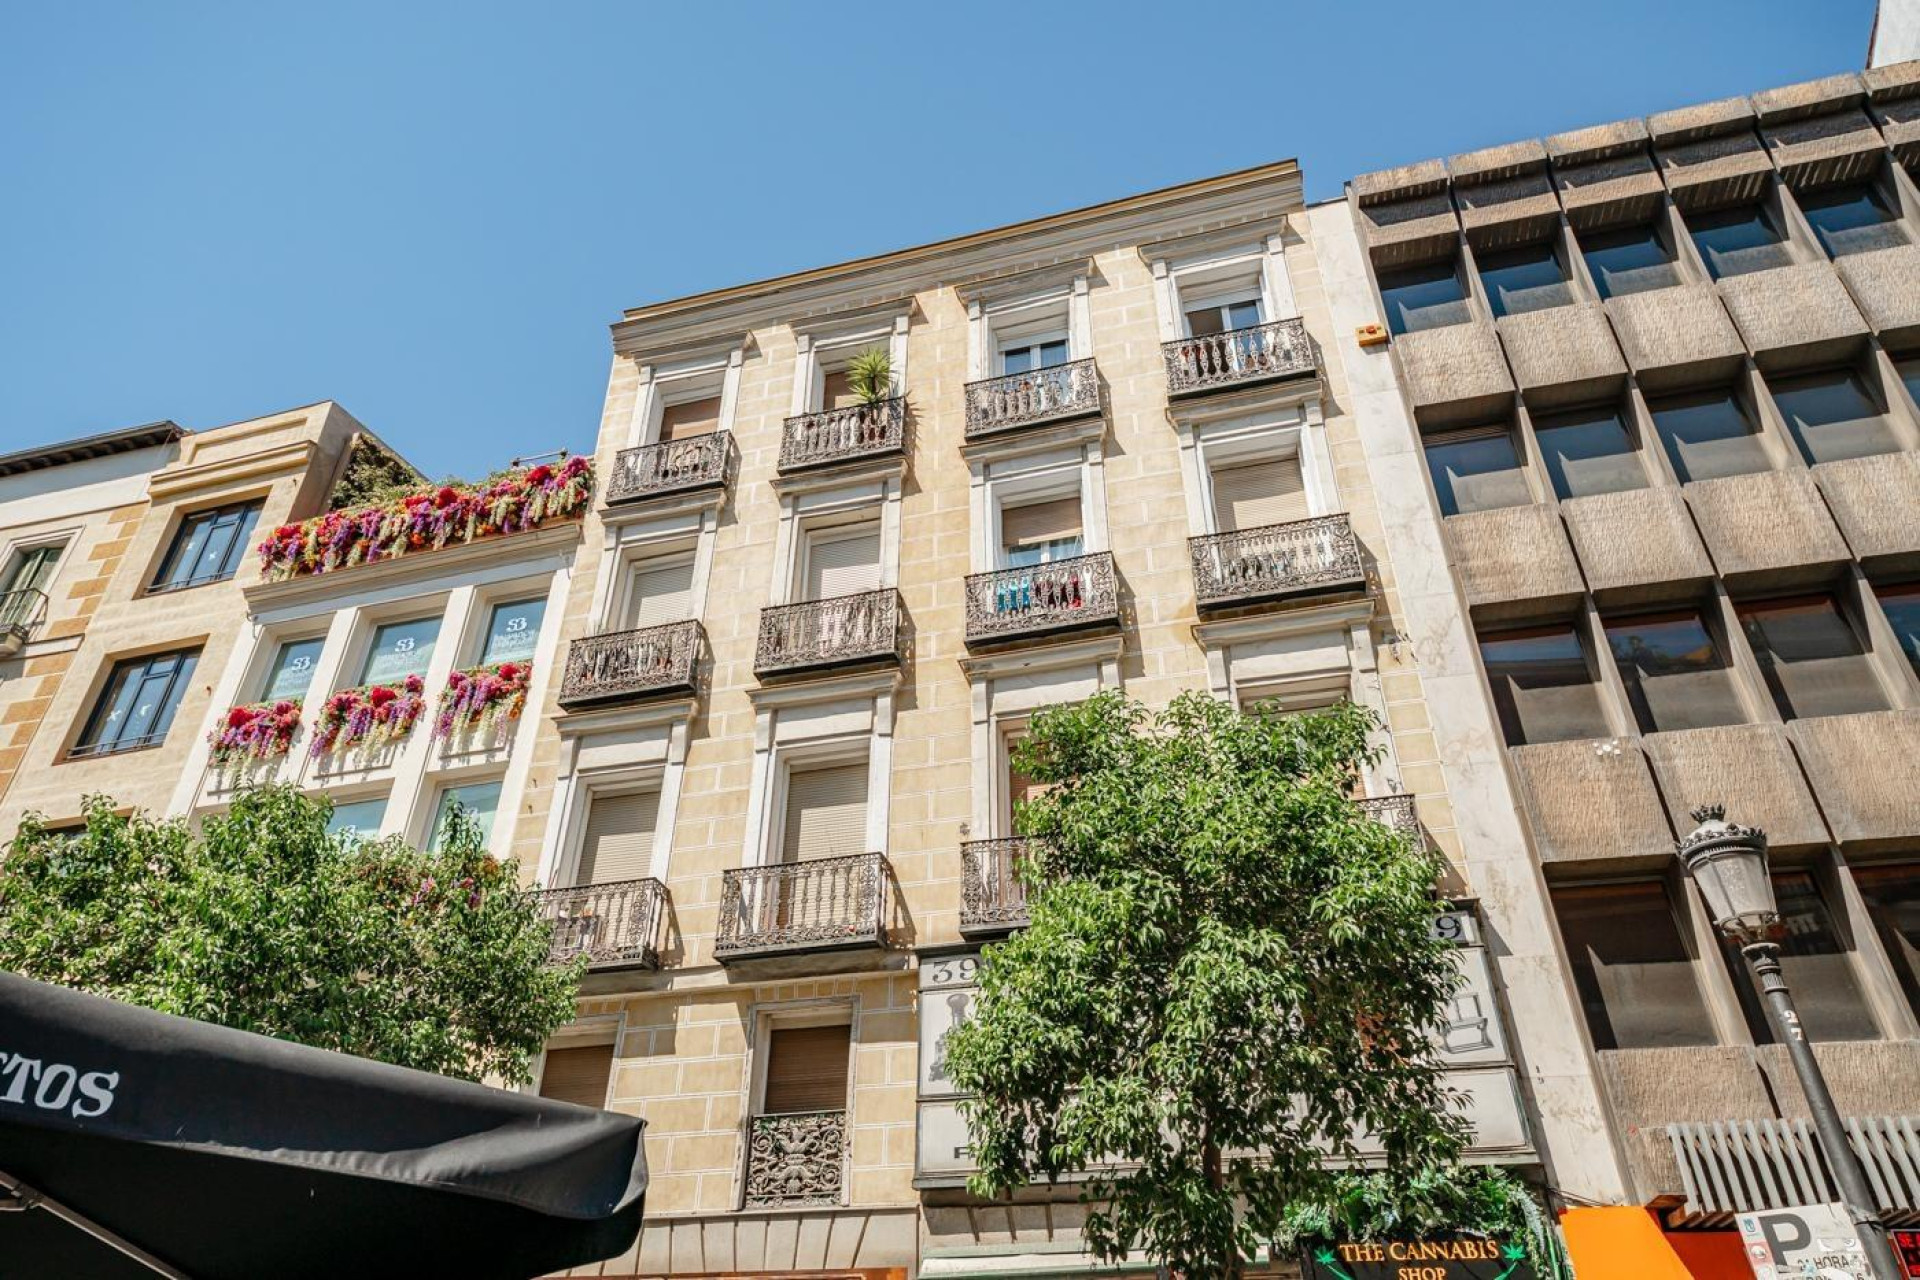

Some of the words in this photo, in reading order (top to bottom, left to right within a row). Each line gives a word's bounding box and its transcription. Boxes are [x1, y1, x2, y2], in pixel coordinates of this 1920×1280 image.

[932, 957, 980, 983] 39
[0, 1051, 120, 1119] TOS
[1339, 1243, 1385, 1262] THE
[1389, 1239, 1500, 1262] CANNABIS
[1757, 1213, 1811, 1266] P
[1398, 1267, 1447, 1280] SHOP
[1812, 1254, 1858, 1270] HORA
